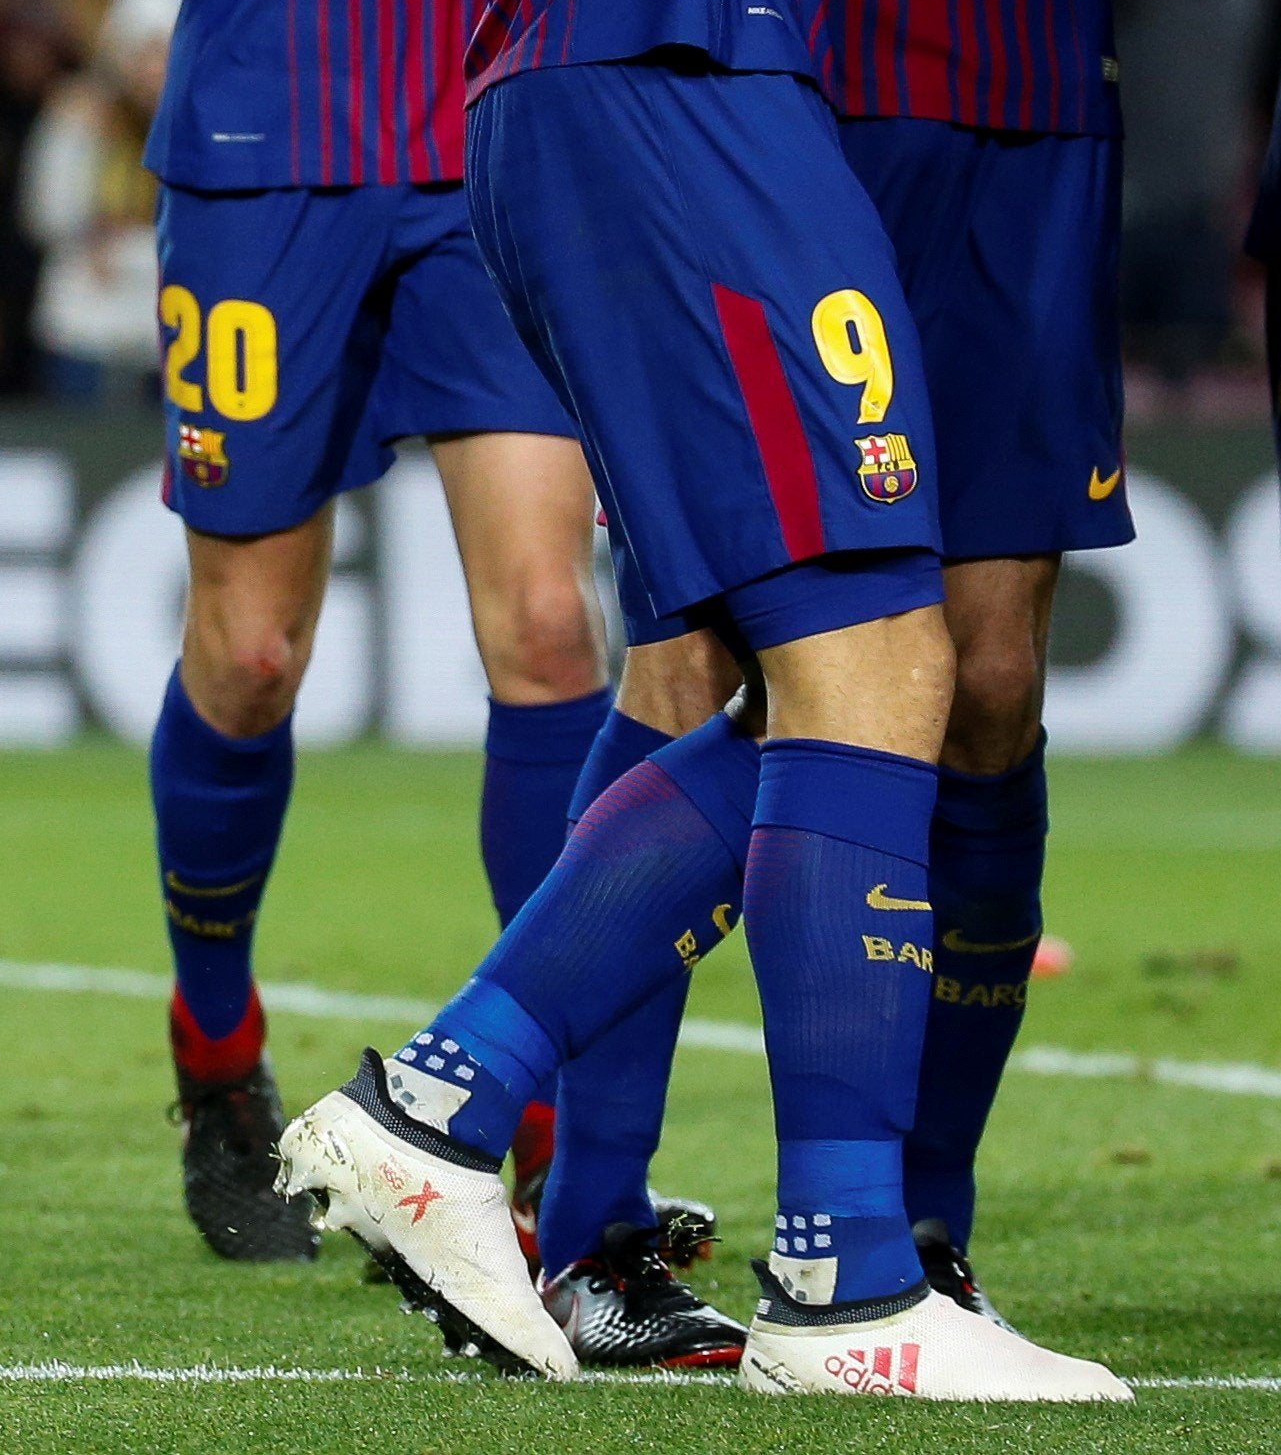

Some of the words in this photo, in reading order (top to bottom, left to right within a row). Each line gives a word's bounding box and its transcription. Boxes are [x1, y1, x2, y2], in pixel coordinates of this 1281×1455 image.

[157, 285, 278, 423] 20
[810, 288, 894, 424] 9
[862, 934, 934, 974] BAR
